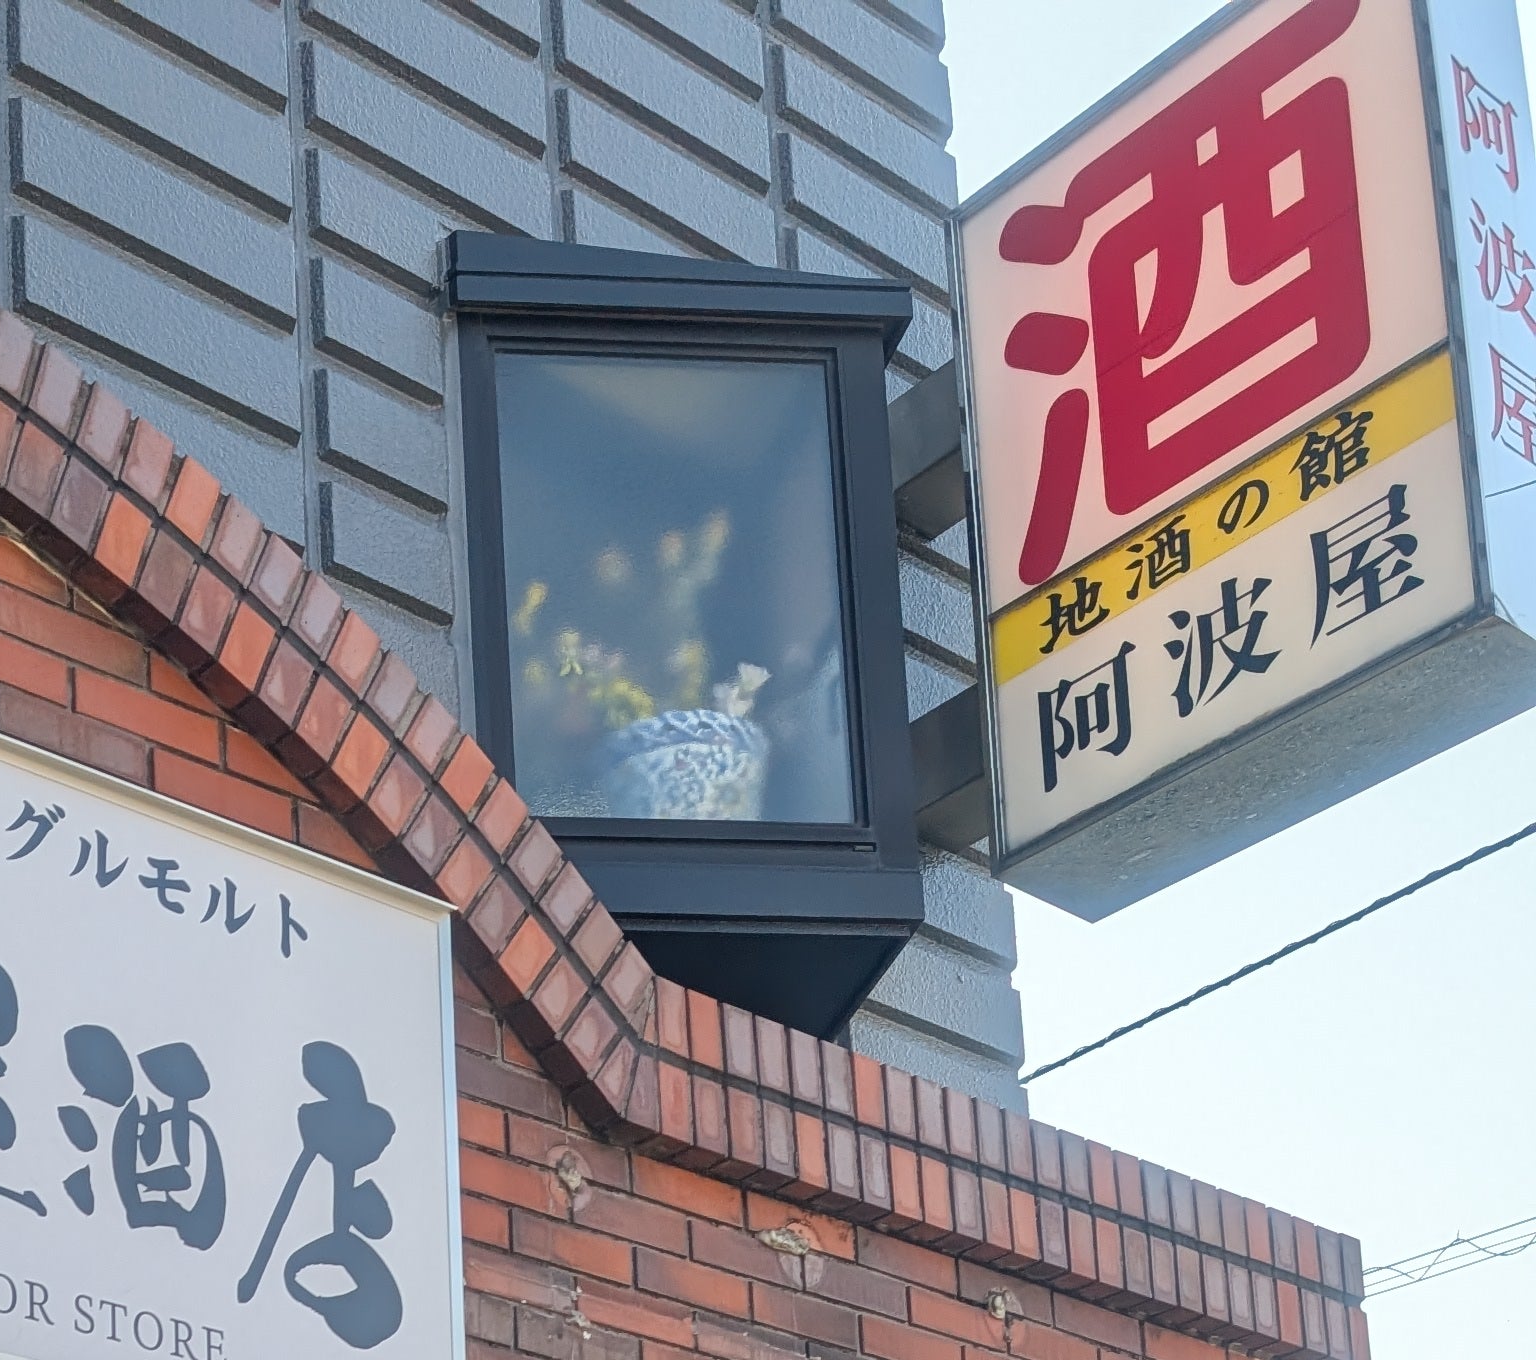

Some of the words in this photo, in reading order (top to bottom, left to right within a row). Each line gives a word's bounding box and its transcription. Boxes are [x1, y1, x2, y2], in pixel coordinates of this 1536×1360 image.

[999, 0, 1371, 586] 酒
[1037, 483, 1424, 793] 阿波屋
[1039, 411, 1373, 655] 地酒の館
